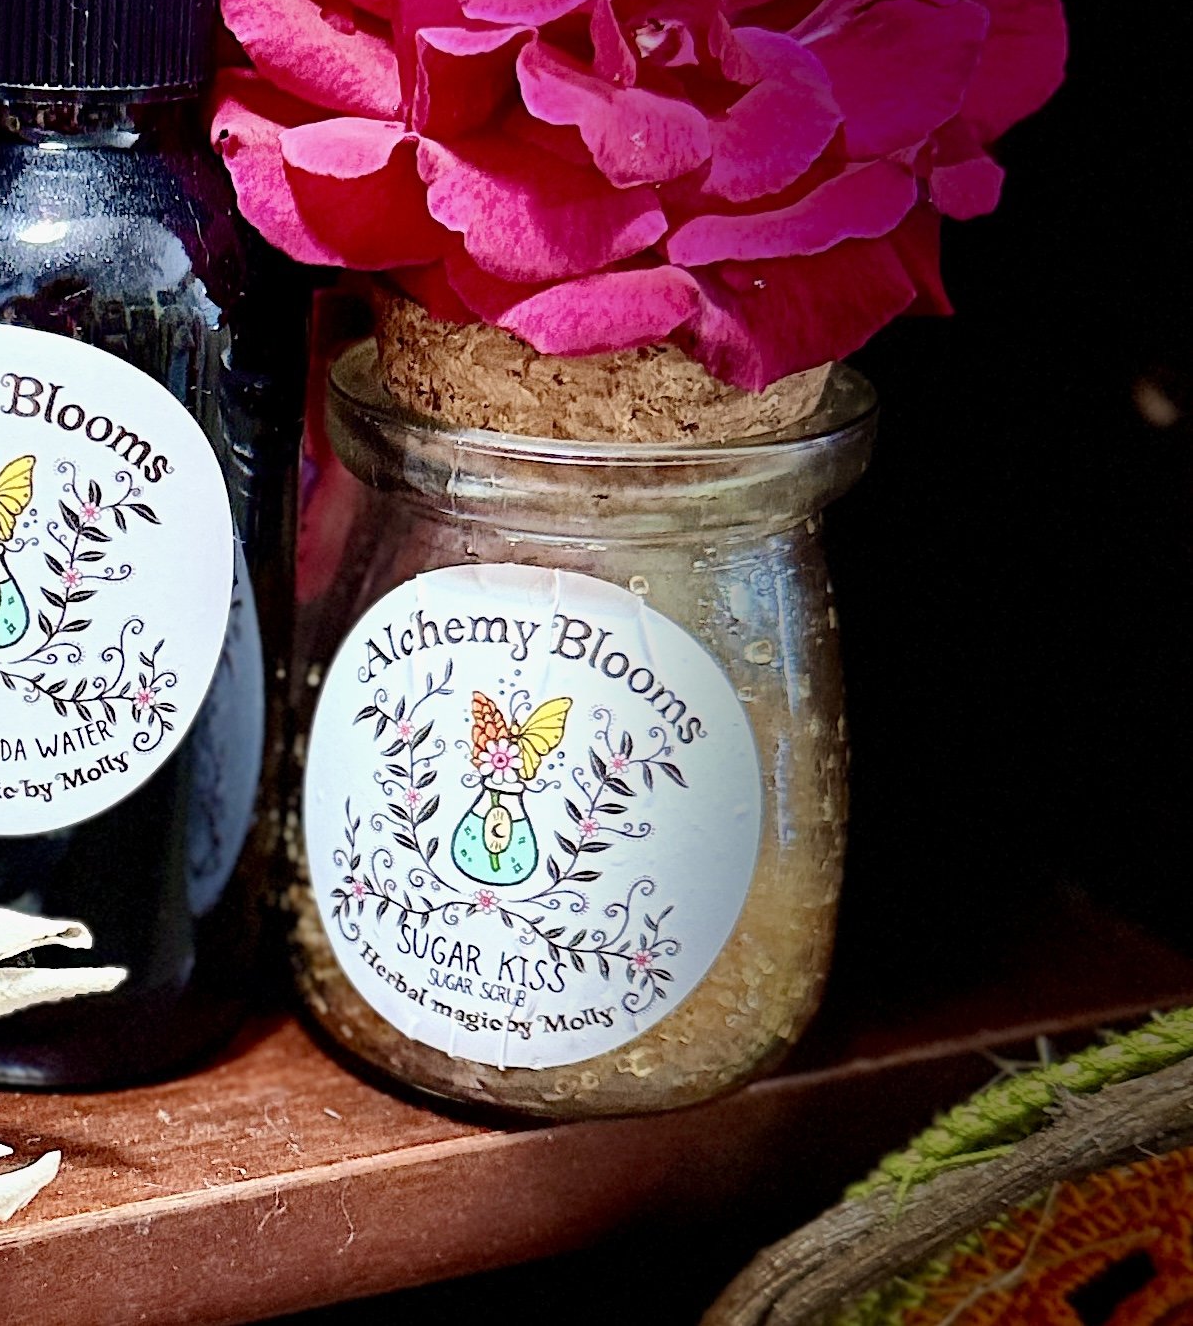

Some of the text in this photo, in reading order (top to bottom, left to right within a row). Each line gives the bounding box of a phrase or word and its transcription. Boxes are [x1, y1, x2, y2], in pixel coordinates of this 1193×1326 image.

[0, 373, 174, 483] Blooms
[357, 609, 708, 745] Alchemy Blooms
[35, 720, 114, 758] WATER
[19, 779, 53, 802] by
[54, 750, 130, 791] Molly
[359, 941, 617, 1040] Herbal magic by Molly
[396, 924, 568, 994] SUGAR KISS
[427, 968, 527, 1007] SUGAR SCRUB
